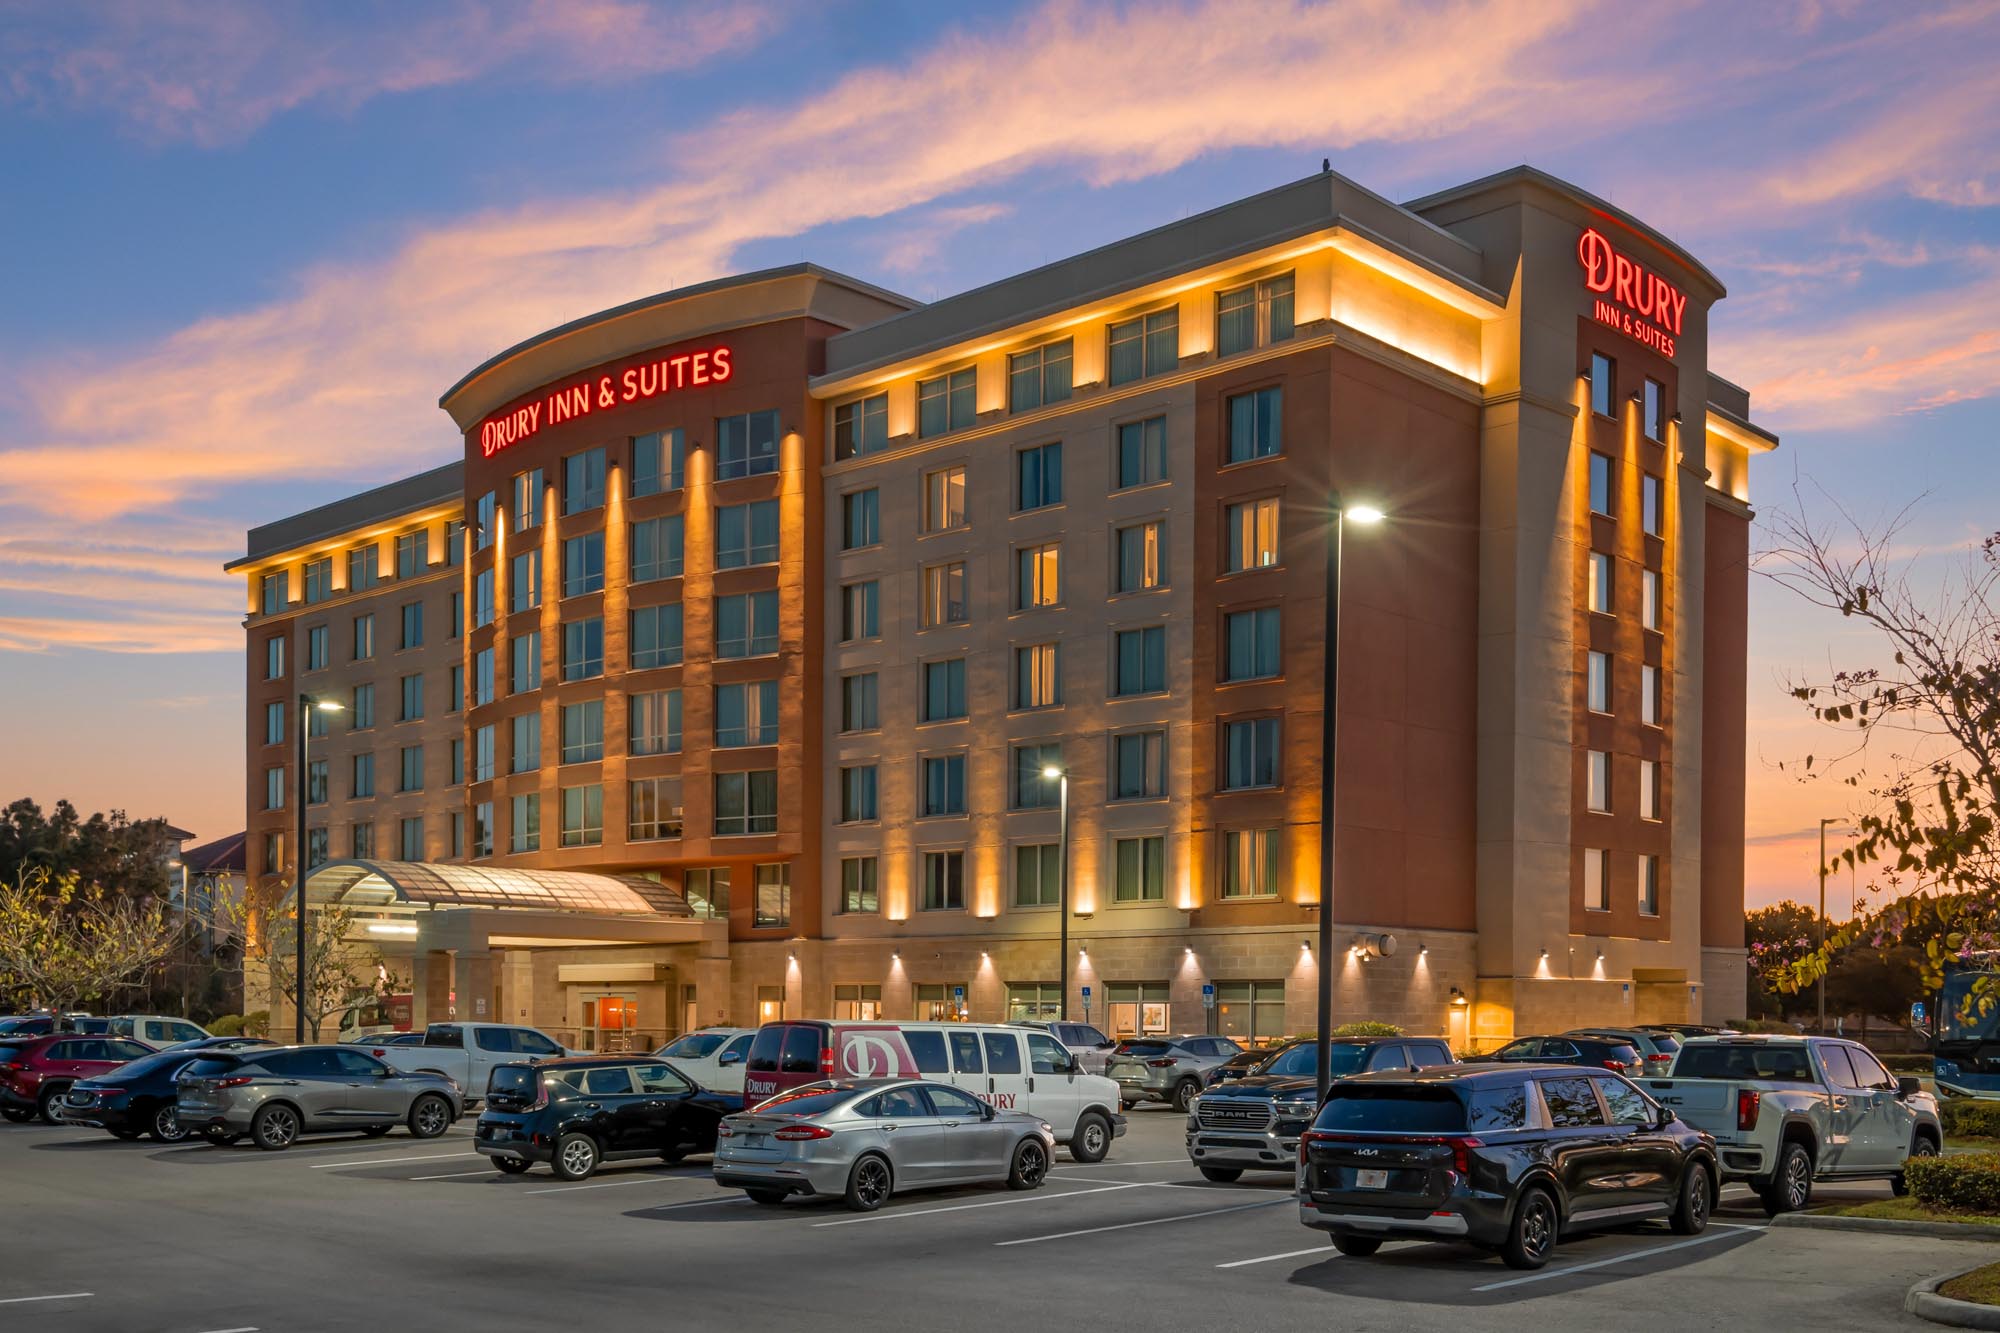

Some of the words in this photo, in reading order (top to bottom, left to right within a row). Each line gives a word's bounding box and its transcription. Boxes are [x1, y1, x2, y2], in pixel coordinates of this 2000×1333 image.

[1579, 228, 1686, 336] DRURY
[1595, 300, 1620, 328] INN
[1623, 314, 1632, 334] &
[1635, 320, 1674, 357] SUITES
[481, 402, 541, 457] DRURY
[548, 384, 590, 425] INN
[598, 377, 615, 408] &
[622, 348, 731, 401] SUITES
[747, 1078, 777, 1094] DRURY
[969, 1090, 1016, 1109] URY
[1654, 1096, 1683, 1105] MC
